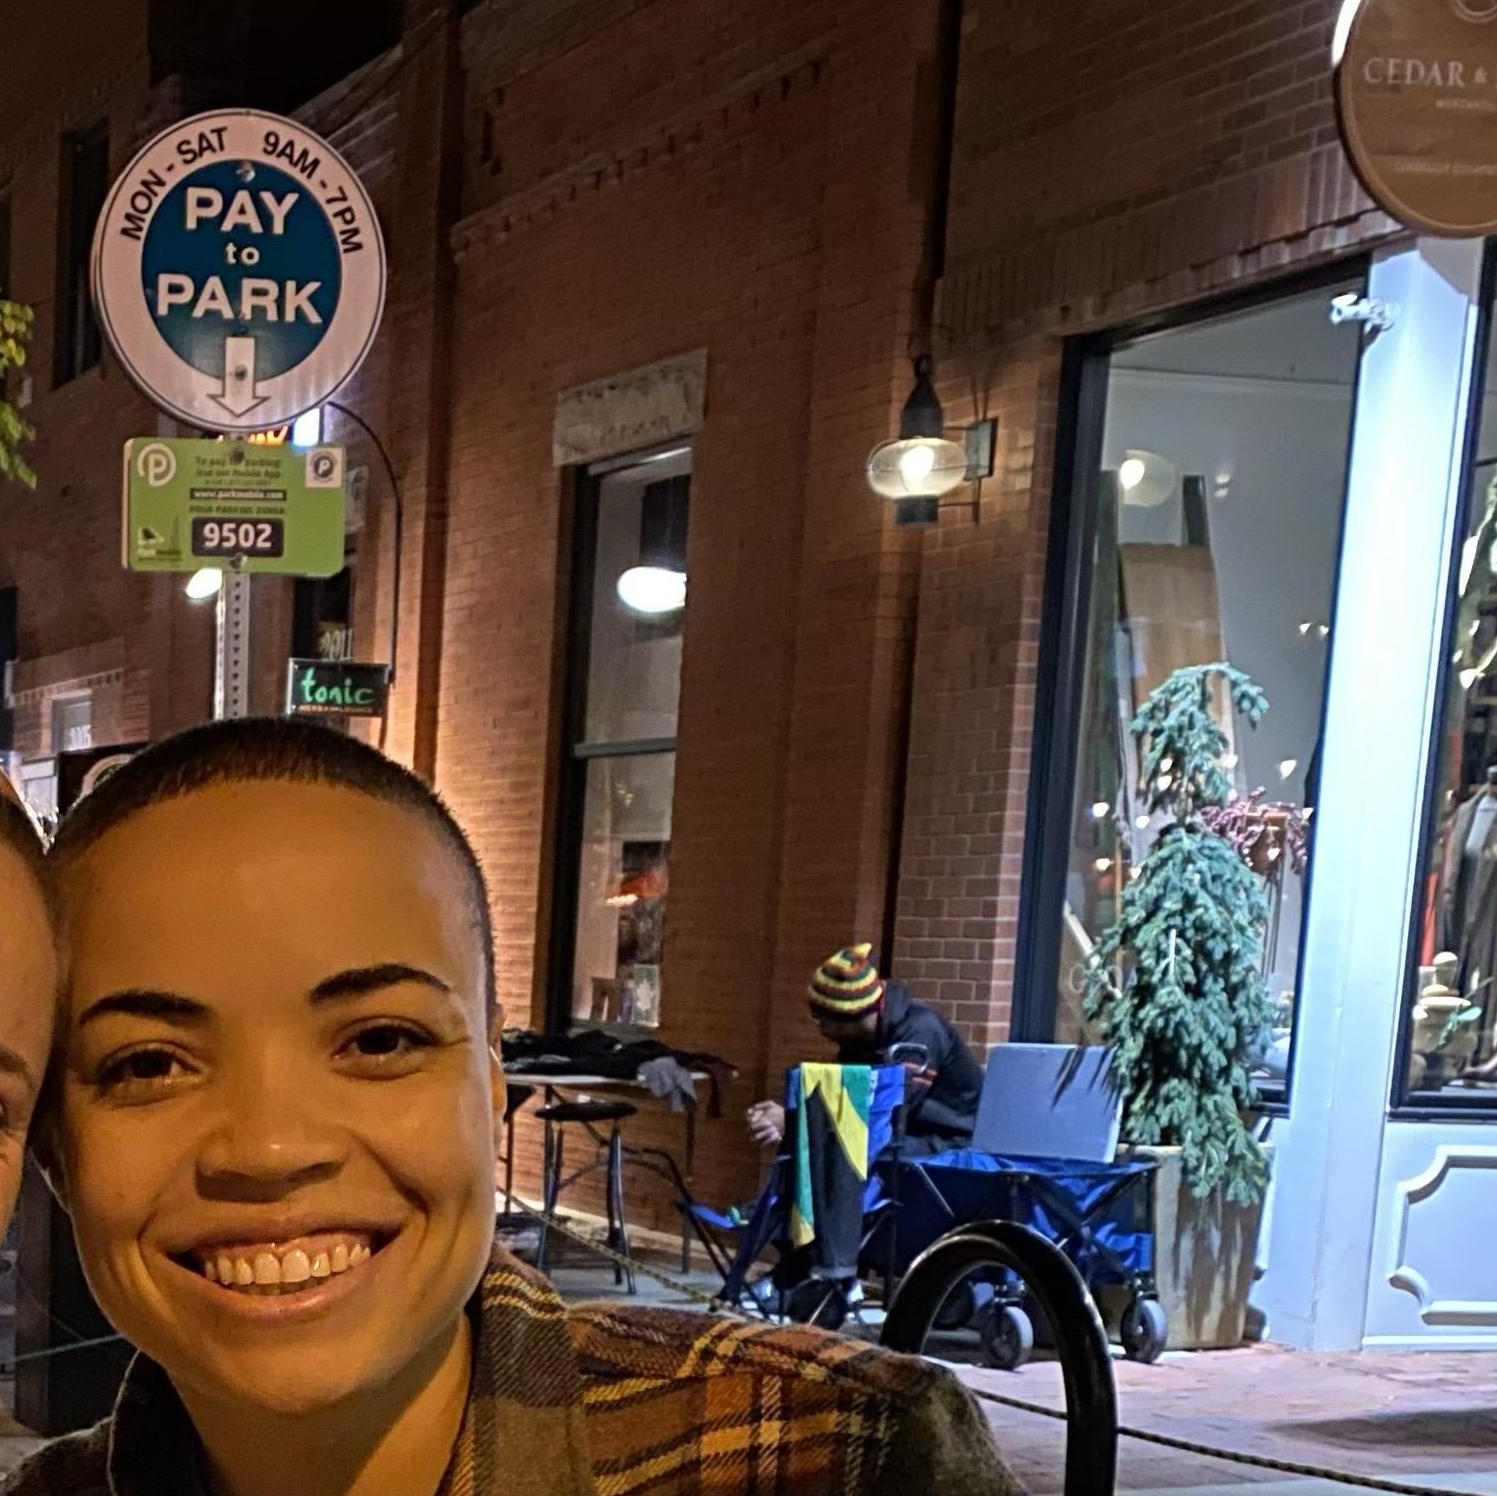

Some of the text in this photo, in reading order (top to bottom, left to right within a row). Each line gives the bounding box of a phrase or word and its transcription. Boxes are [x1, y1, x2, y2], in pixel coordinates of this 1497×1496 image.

[1364, 57, 1488, 87] CEDAR &
[120, 169, 167, 241] MON
[177, 127, 229, 165] SAT
[263, 131, 321, 180] 9AM
[325, 186, 364, 255] 7PM
[185, 187, 301, 236] PAY
[225, 242, 260, 265] to
[155, 273, 323, 324] PARK
[203, 522, 273, 548] 9502
[301, 667, 374, 705] tonic
